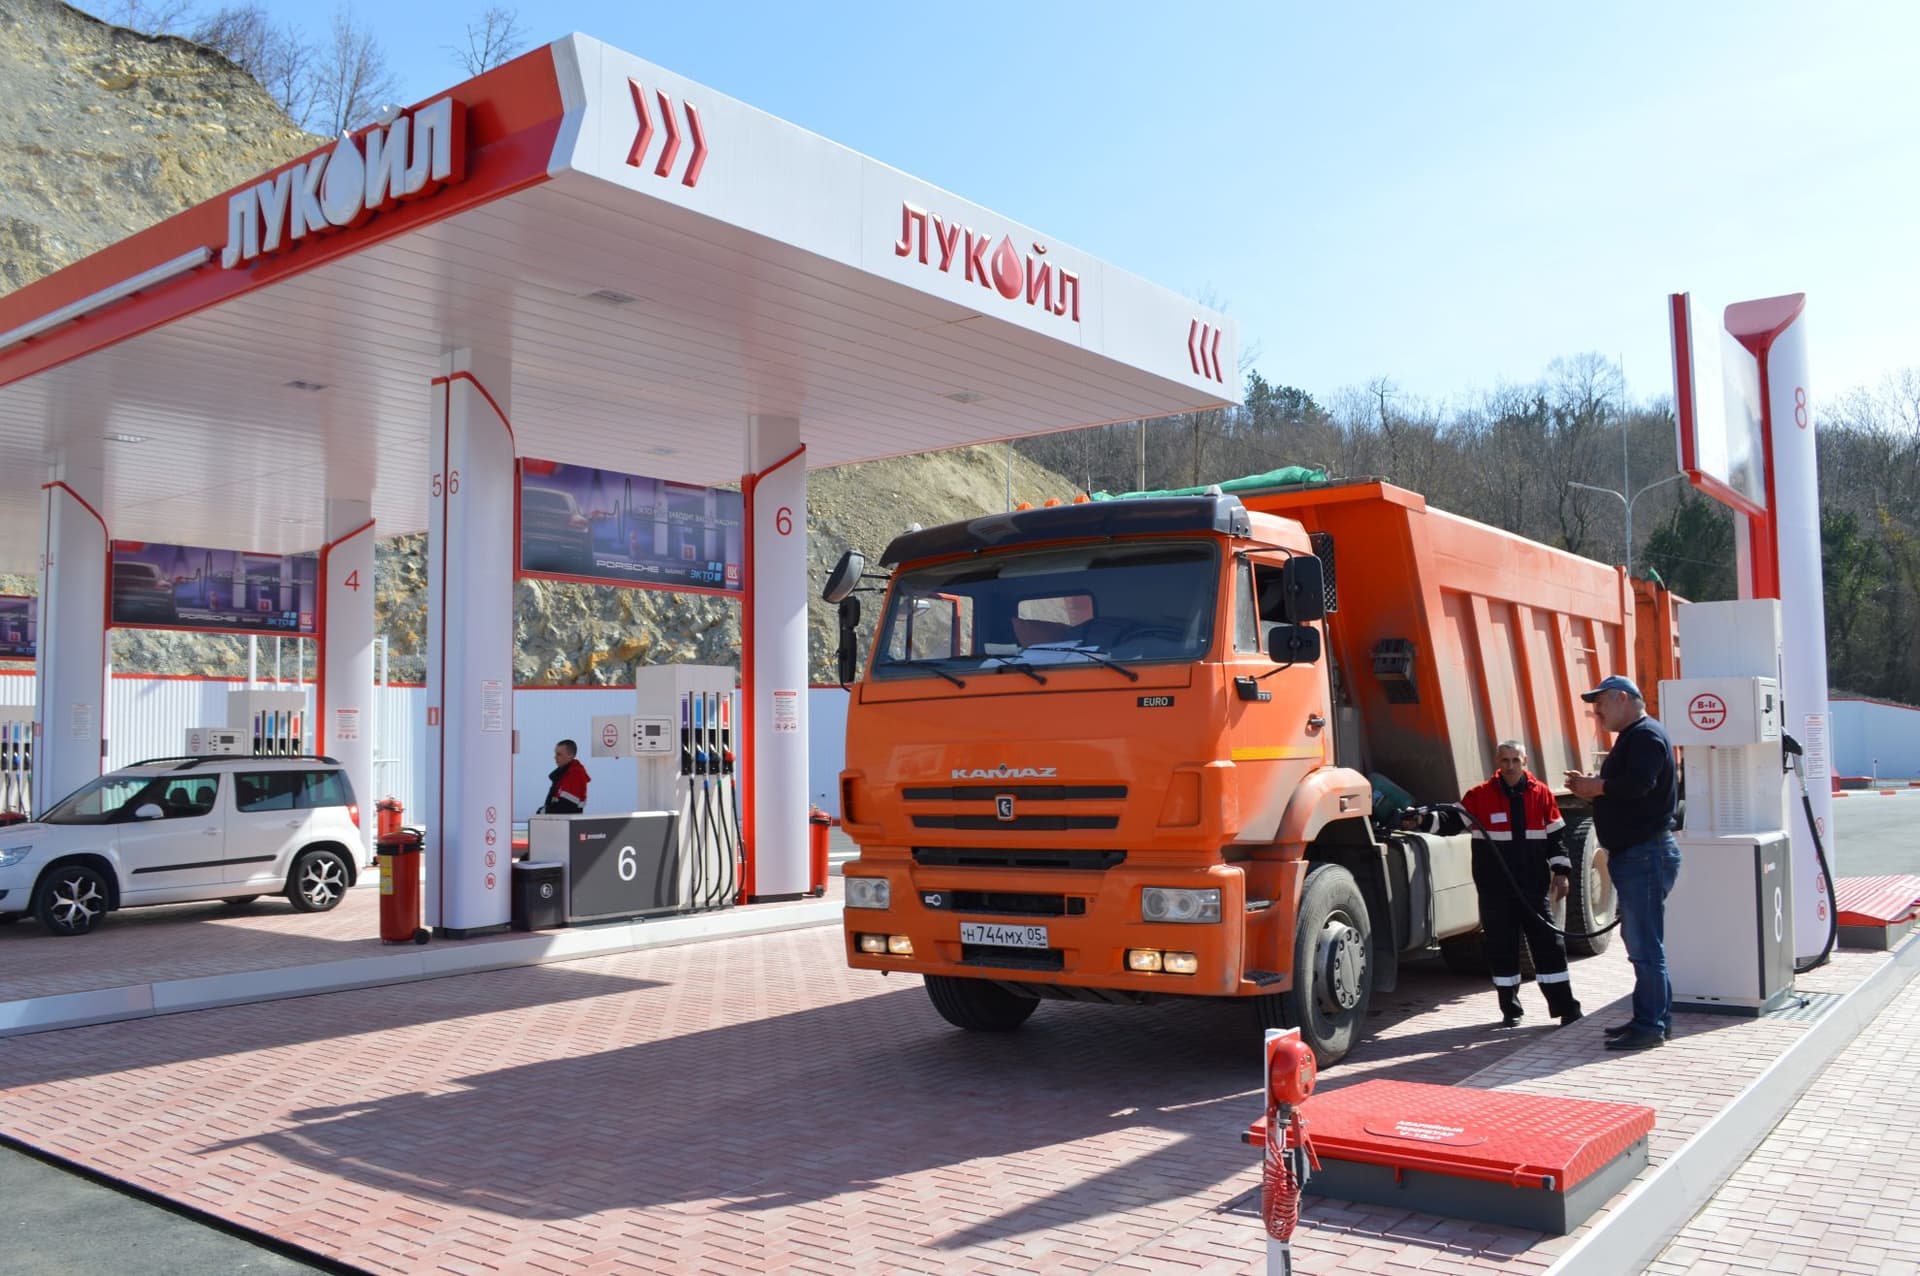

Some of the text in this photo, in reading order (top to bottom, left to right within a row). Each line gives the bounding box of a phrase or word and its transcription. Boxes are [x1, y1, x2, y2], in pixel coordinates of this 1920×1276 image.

[222, 96, 452, 270] ЛУКОЙЛ
[895, 200, 1080, 323] ЛУКОЙЛ
[1794, 386, 1807, 430] 8
[432, 473, 442, 497] 5
[449, 470, 459, 494] 6
[776, 506, 792, 536] 6
[596, 560, 660, 574] PORSCHE
[344, 568, 360, 592] 4
[1143, 697, 1169, 707] EURO
[952, 767, 1057, 778] KAMAZ
[618, 845, 637, 881] 6
[1774, 886, 1783, 943] 8
[1027, 927, 1041, 941] 05
